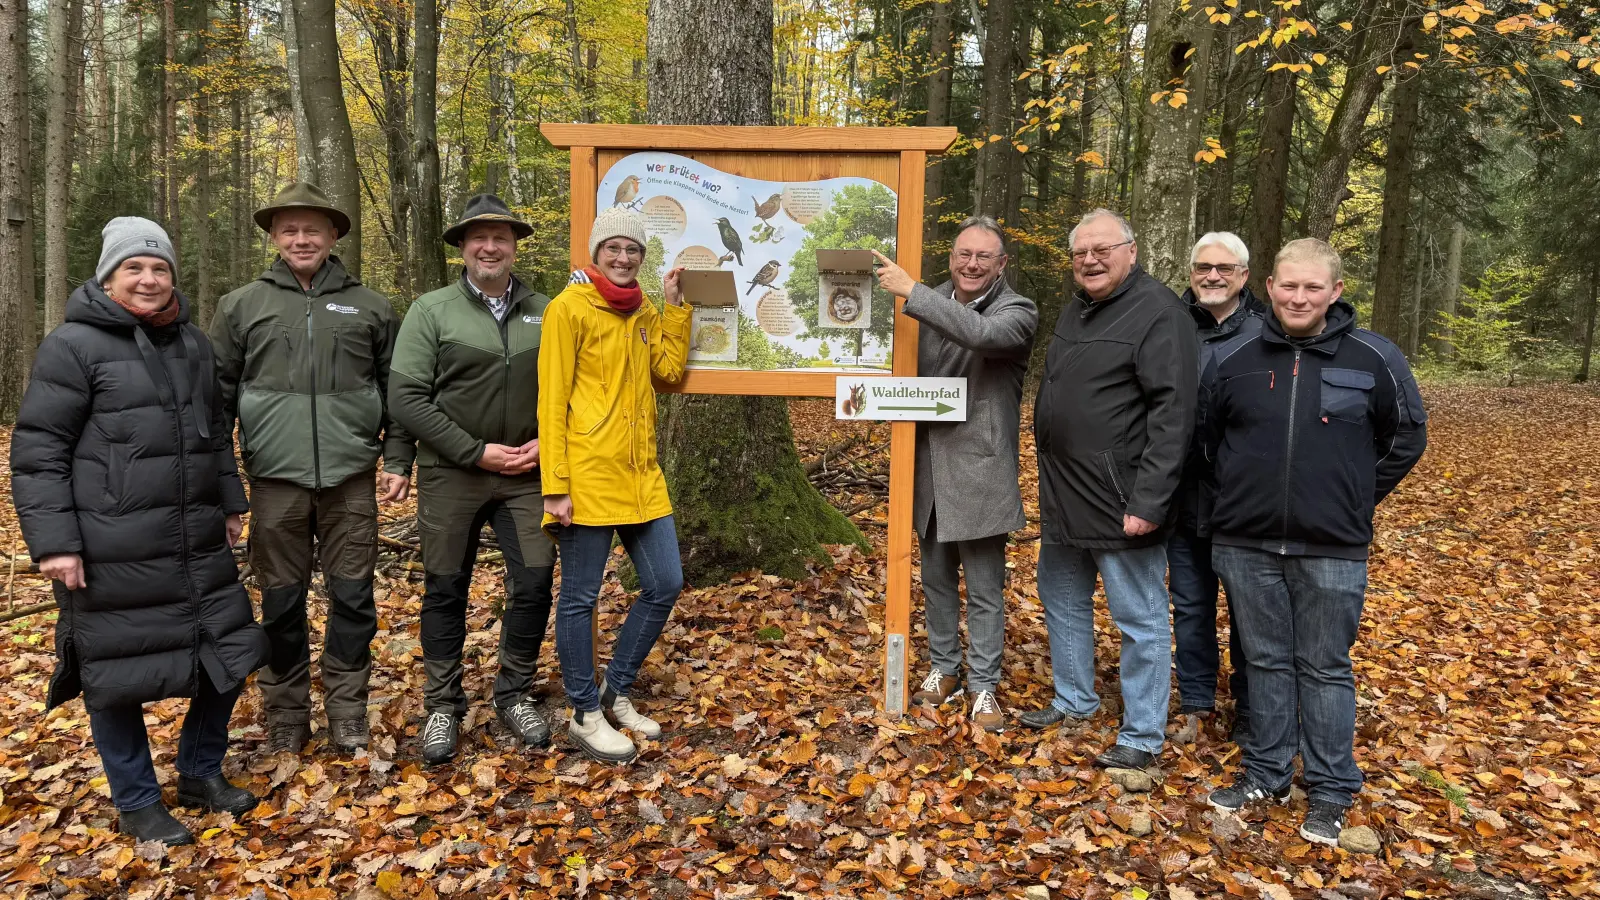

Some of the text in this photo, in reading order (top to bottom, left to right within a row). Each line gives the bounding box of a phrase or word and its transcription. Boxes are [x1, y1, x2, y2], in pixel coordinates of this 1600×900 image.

[673, 180, 695, 193] Klappen
[695, 190, 706, 199] und
[705, 194, 720, 206] finde
[719, 201, 729, 209] die
[728, 206, 749, 216] Nester!
[871, 386, 961, 401] Waldlehrpfad
